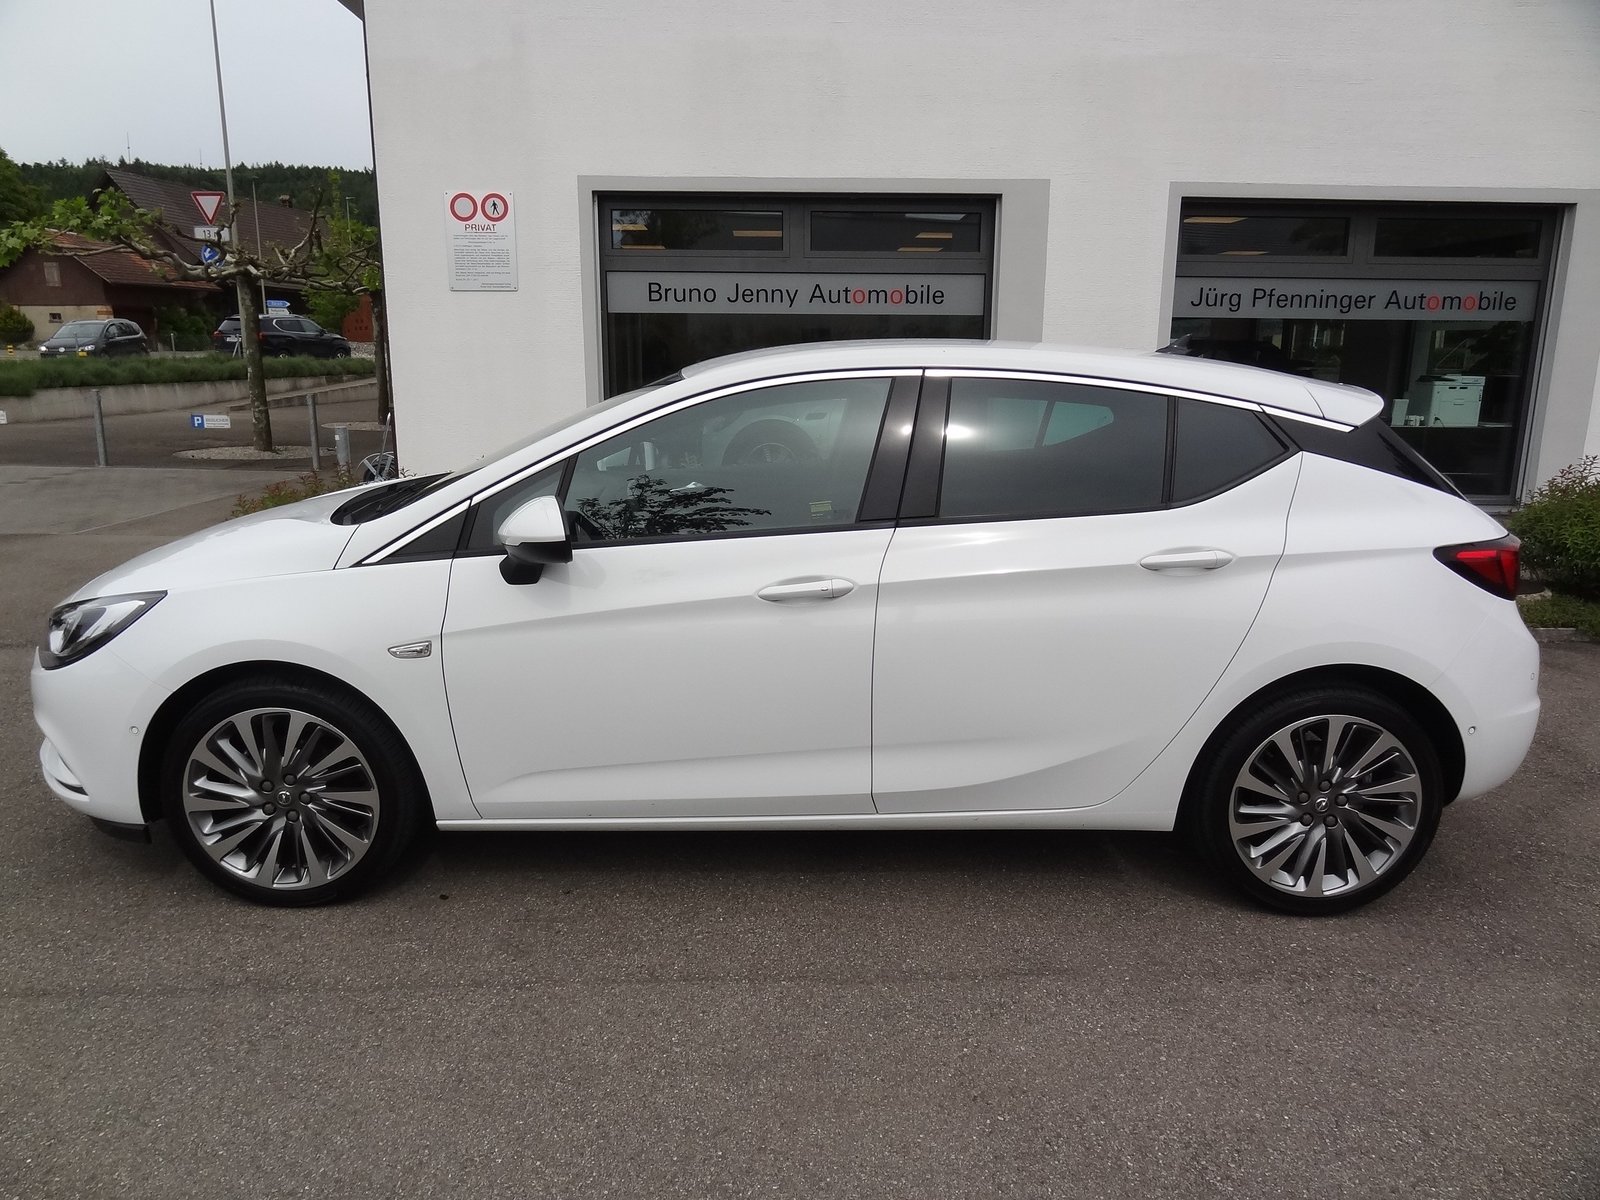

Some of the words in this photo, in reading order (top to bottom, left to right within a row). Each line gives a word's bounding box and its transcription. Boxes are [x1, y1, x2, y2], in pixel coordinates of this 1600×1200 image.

[203, 229, 211, 239] 13
[648, 282, 717, 303] Bruno
[727, 283, 799, 307] Jenny
[808, 283, 945, 305] Automobile
[1190, 287, 1242, 312] Jürg
[1251, 288, 1376, 313] Pfenninger
[1385, 290, 1517, 312] Automobile
[194, 416, 202, 427] P
